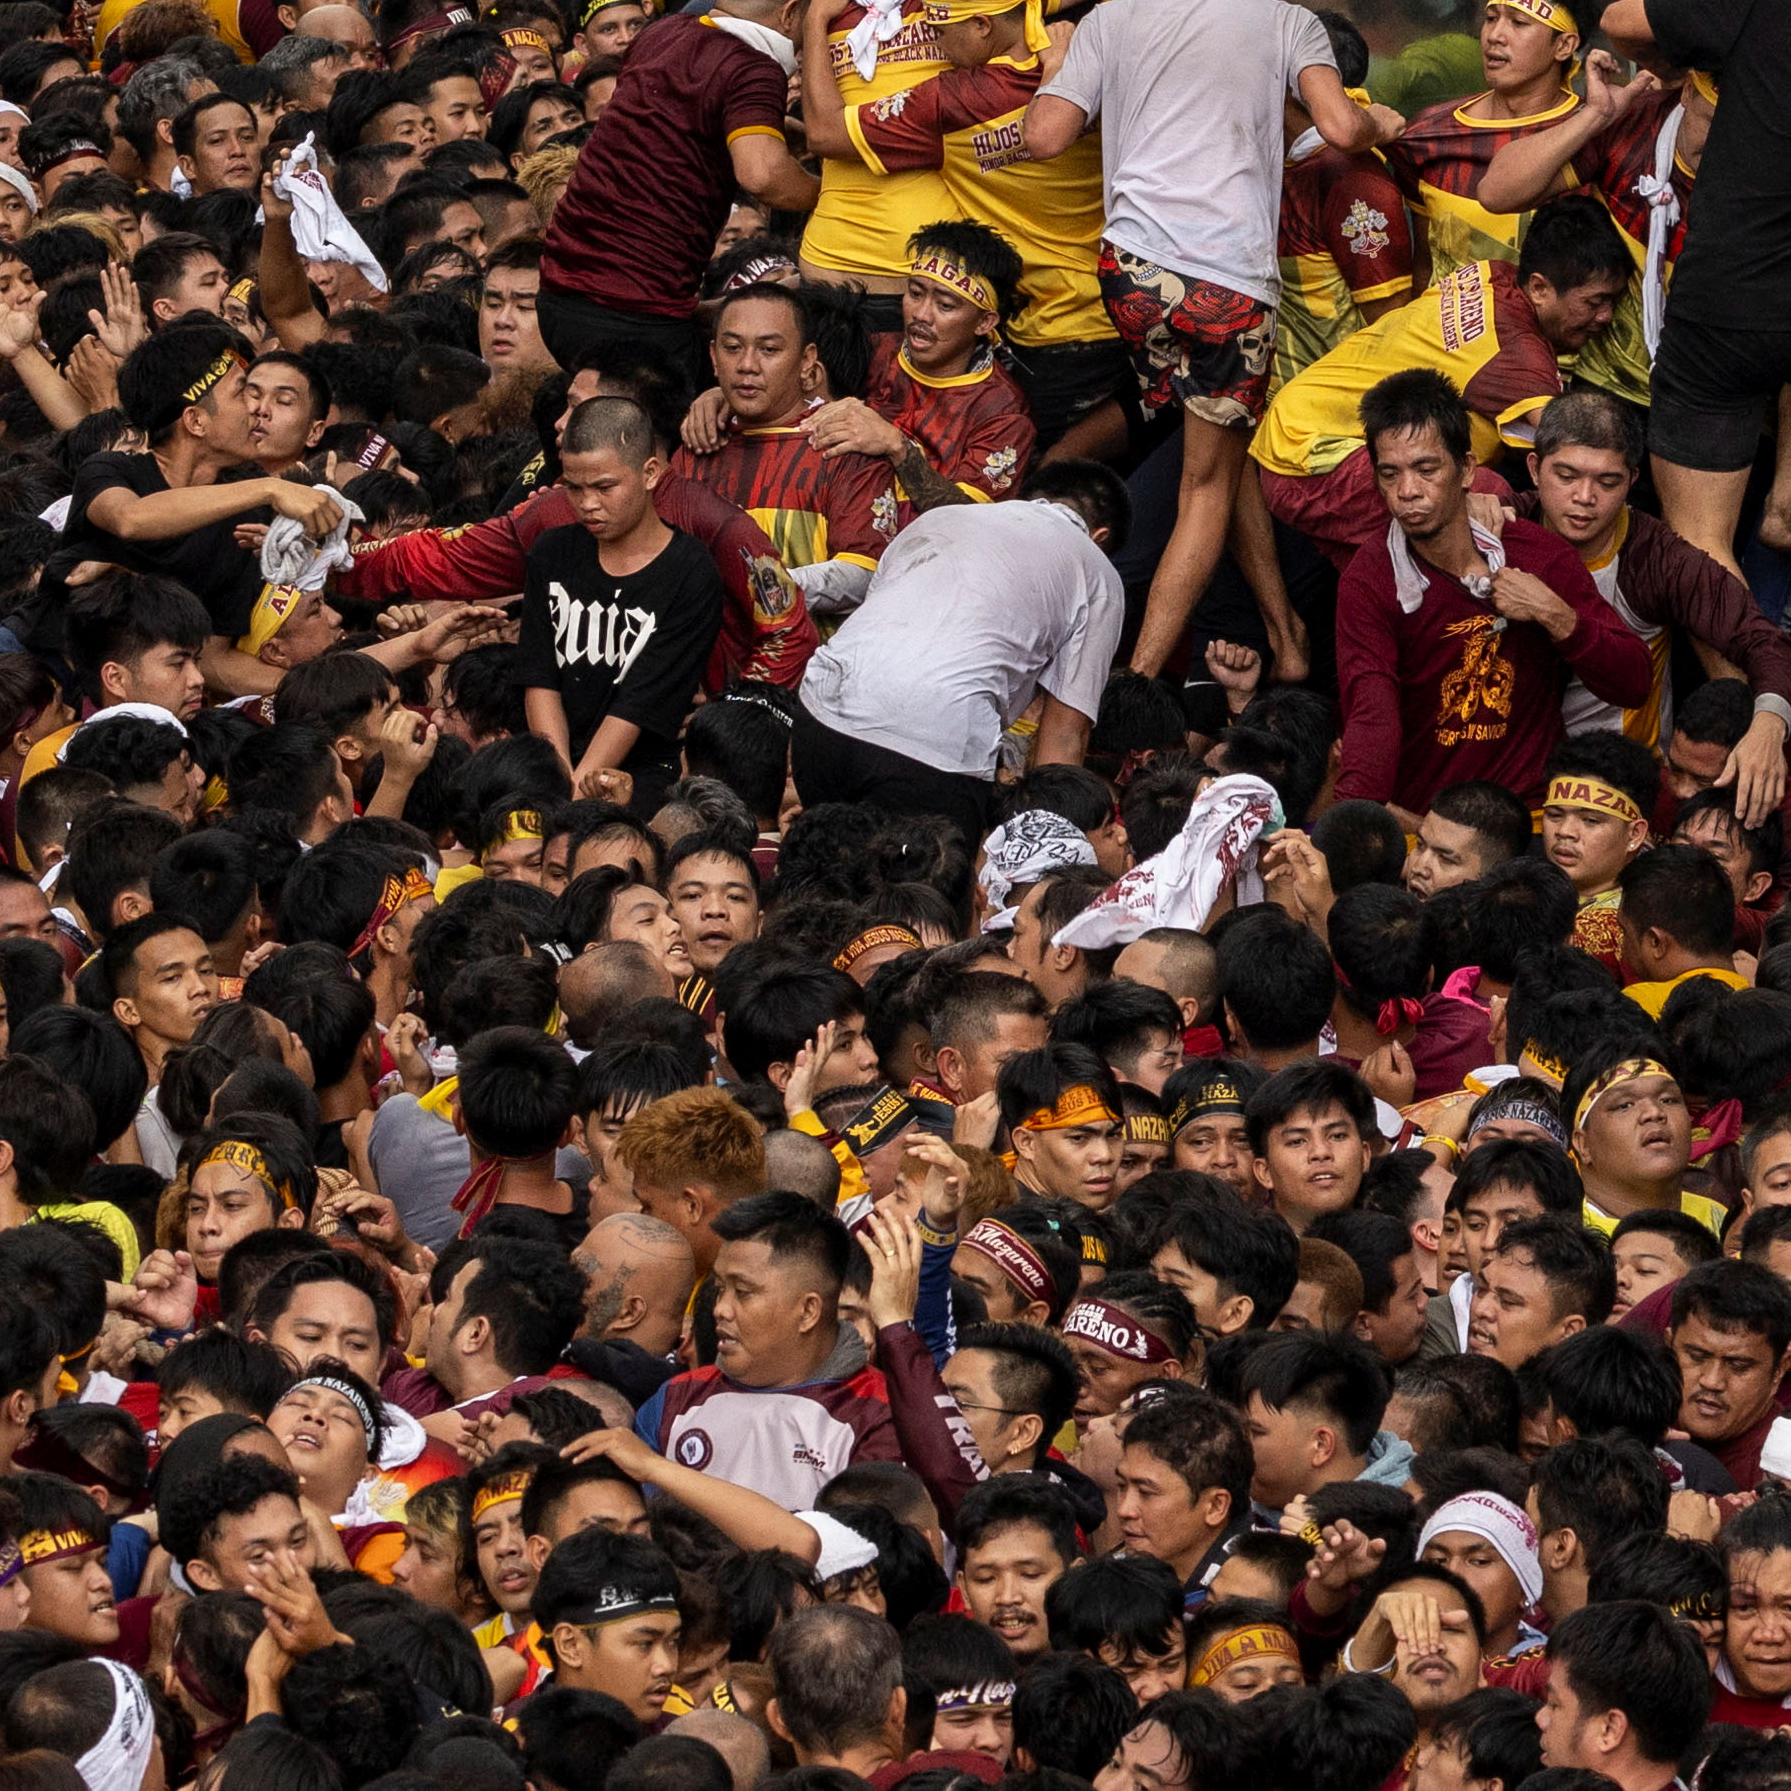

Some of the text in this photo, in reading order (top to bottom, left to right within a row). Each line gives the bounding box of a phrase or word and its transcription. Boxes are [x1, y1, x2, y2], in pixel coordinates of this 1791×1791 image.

[973, 121, 1022, 156] HIJOS
[184, 372, 217, 402] VIVA
[874, 1096, 905, 1126] JESUS
[978, 1227, 1046, 1290] Nazareno
[323, 1375, 375, 1431] NAZARENO
